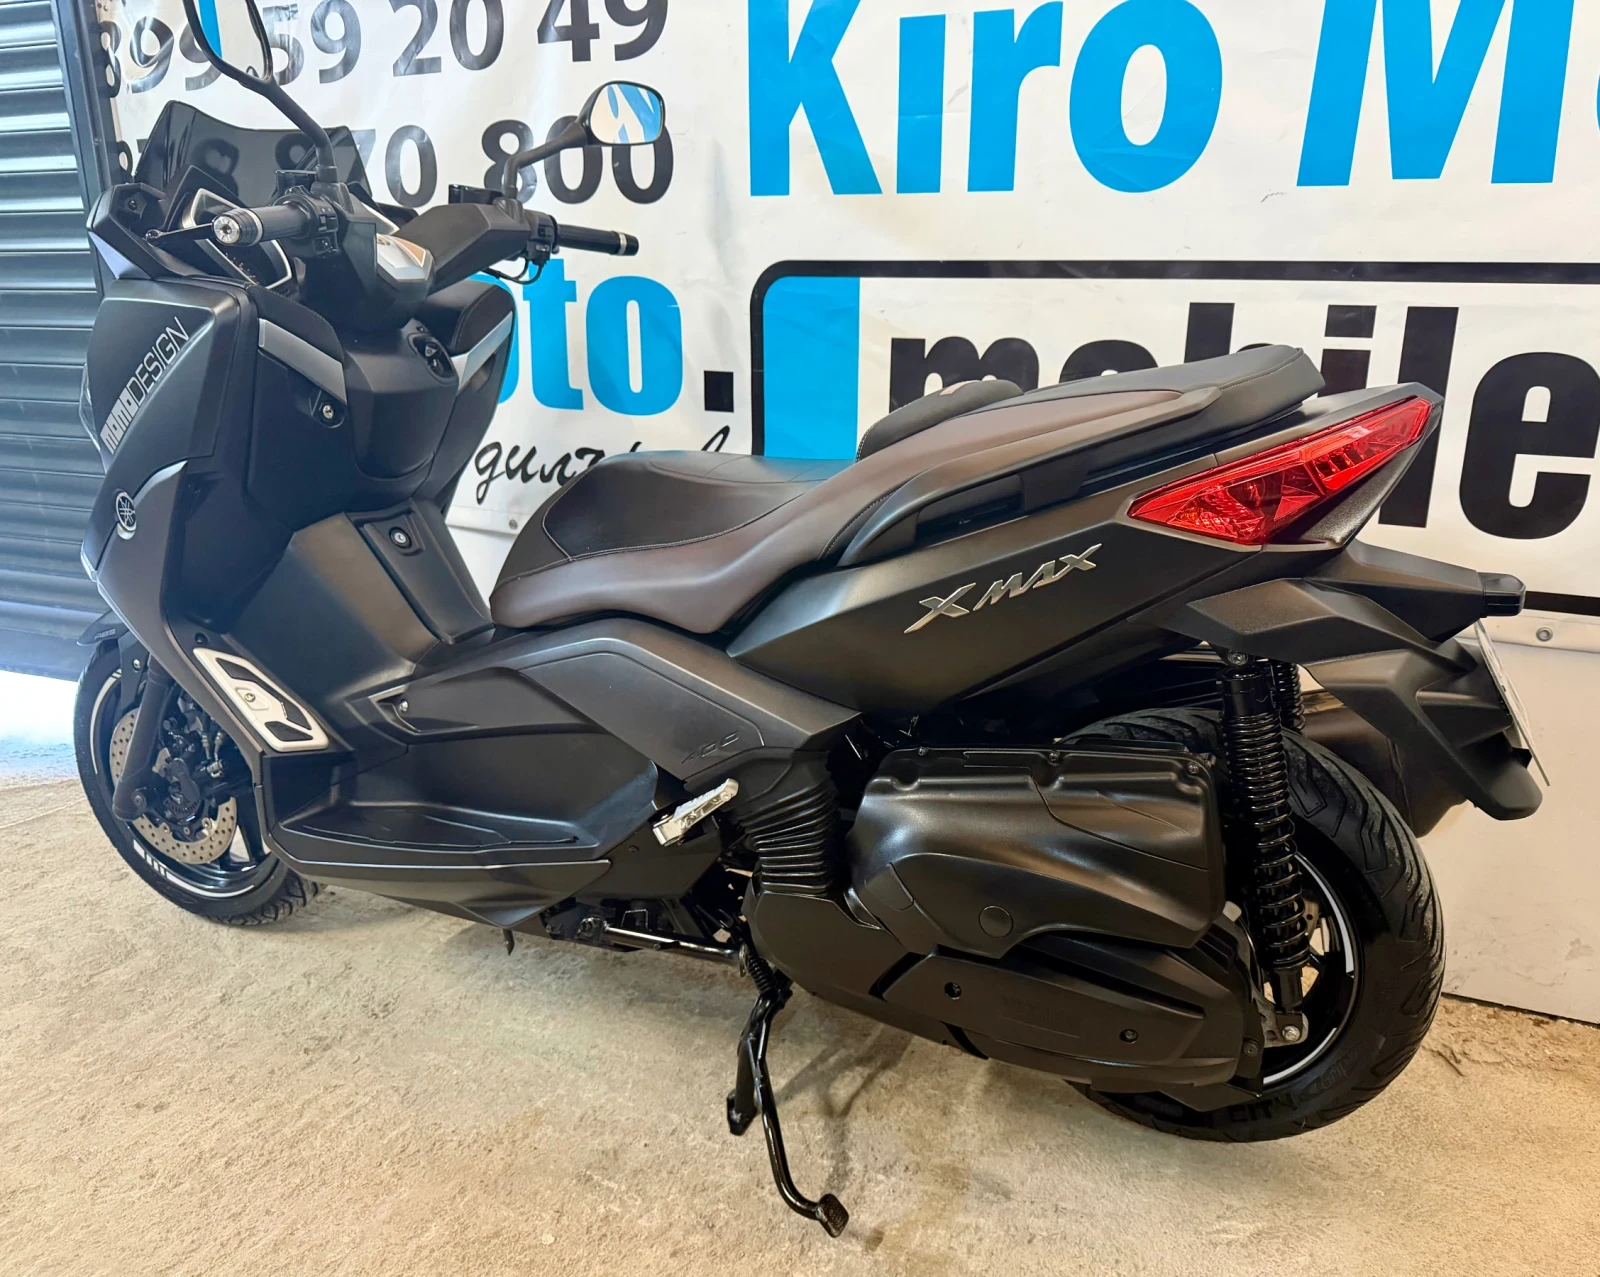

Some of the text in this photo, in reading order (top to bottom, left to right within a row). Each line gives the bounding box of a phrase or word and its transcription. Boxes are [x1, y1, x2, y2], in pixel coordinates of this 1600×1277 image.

[262, 0, 361, 85] 59
[392, 0, 504, 77] 20
[537, 0, 668, 62] 49
[749, 0, 1600, 195] Kiro M
[481, 115, 674, 205] 800
